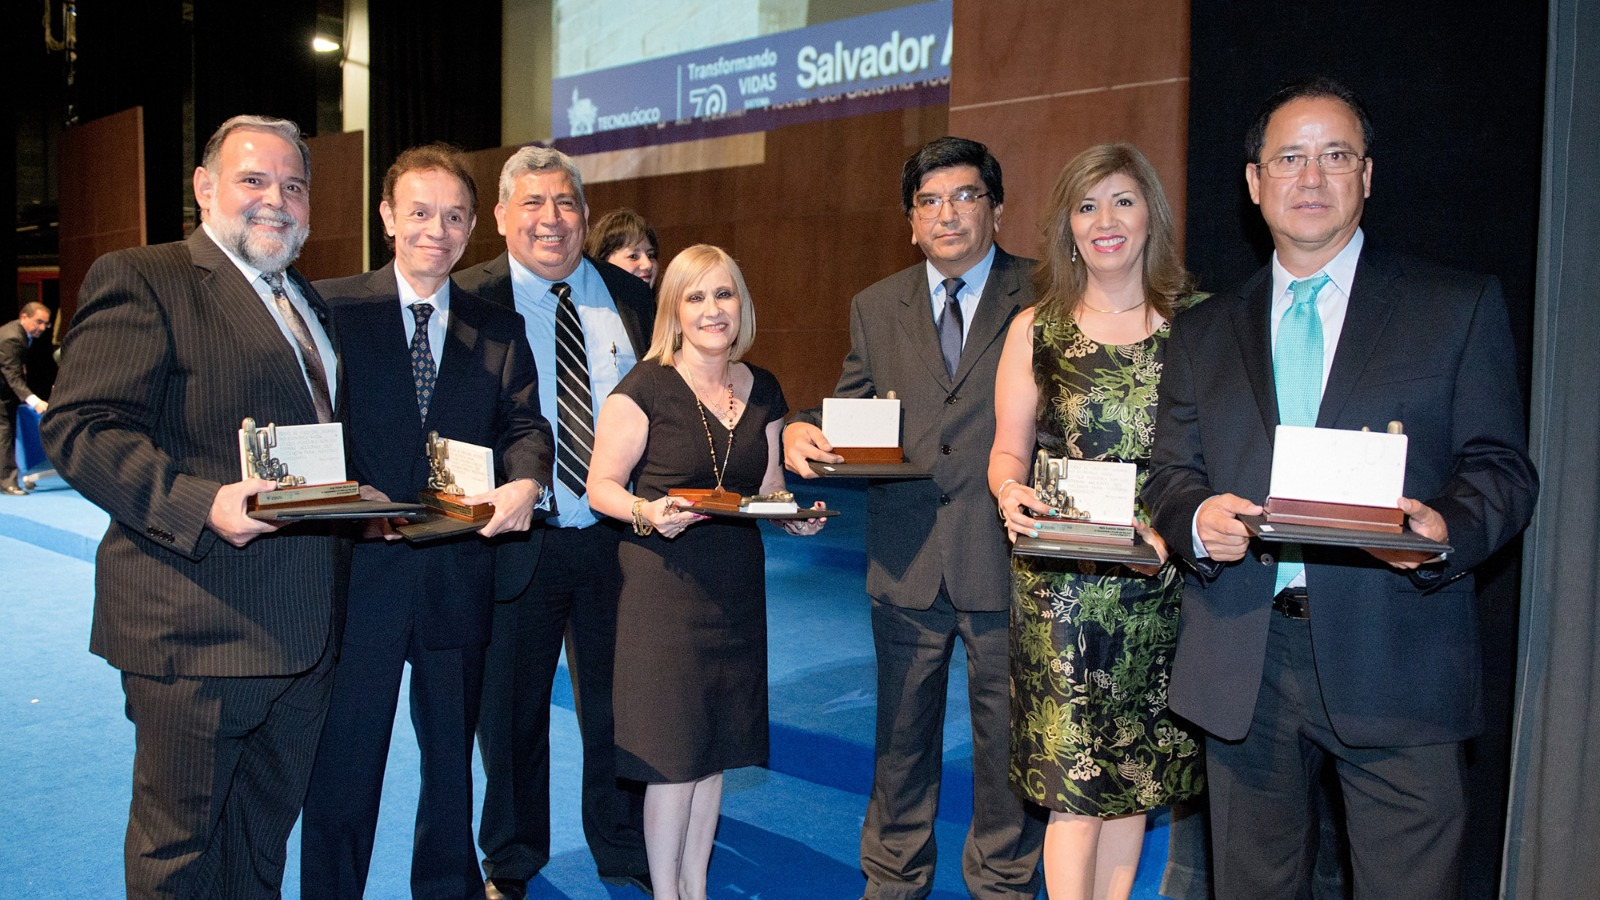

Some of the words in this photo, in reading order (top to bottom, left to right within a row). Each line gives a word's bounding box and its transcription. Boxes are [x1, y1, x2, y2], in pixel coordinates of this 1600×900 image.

[688, 48, 777, 81] Transformando
[797, 29, 936, 88] Salvador
[738, 72, 777, 95] VIDAS
[598, 106, 661, 131] TECNOLÓGICO
